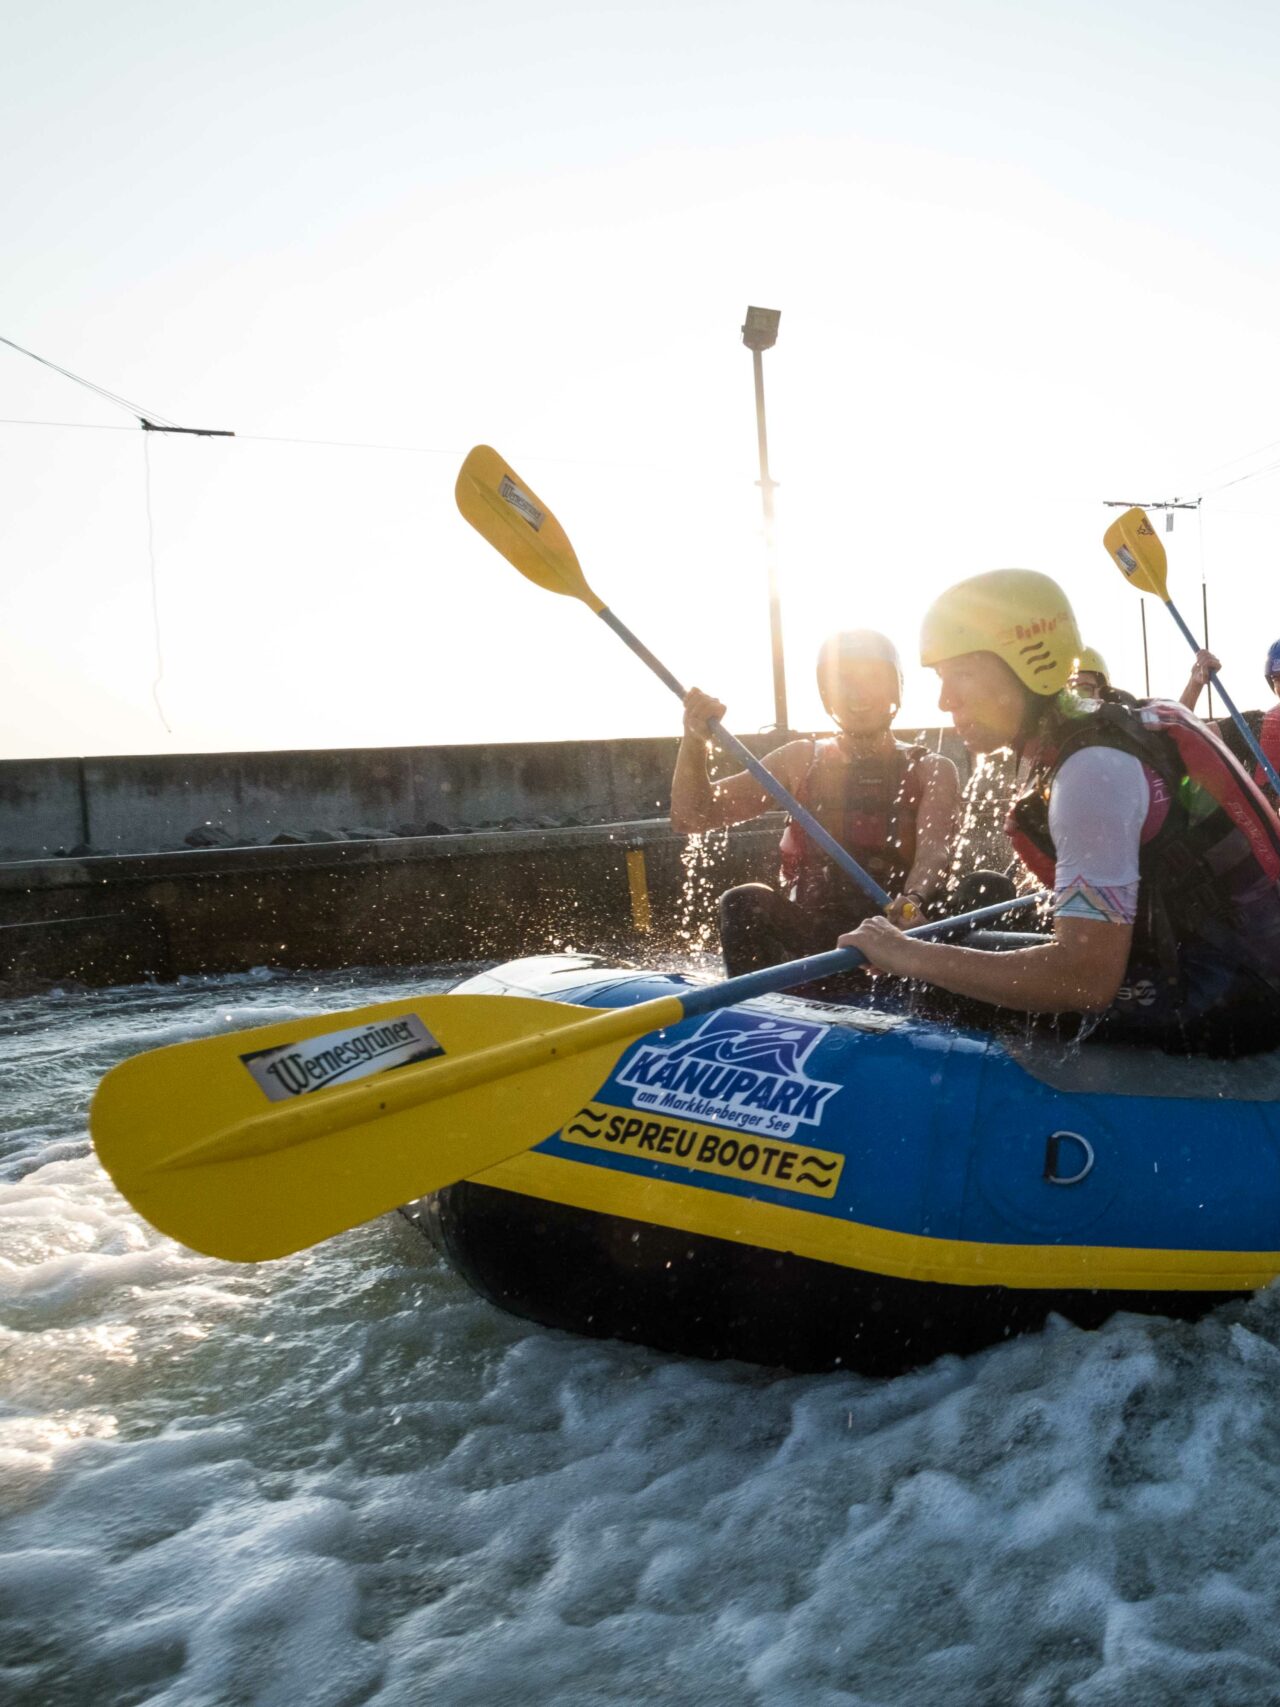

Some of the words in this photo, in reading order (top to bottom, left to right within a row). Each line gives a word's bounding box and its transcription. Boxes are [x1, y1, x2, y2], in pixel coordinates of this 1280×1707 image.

[266, 1020, 416, 1095] Wernesgrüner
[622, 1050, 834, 1120] KANUPARK
[637, 1091, 658, 1105] am
[660, 1092, 764, 1128] Markkleeberger
[765, 1115, 792, 1133] See
[604, 1115, 698, 1158] SPREU
[697, 1138, 799, 1180] BOOTE
